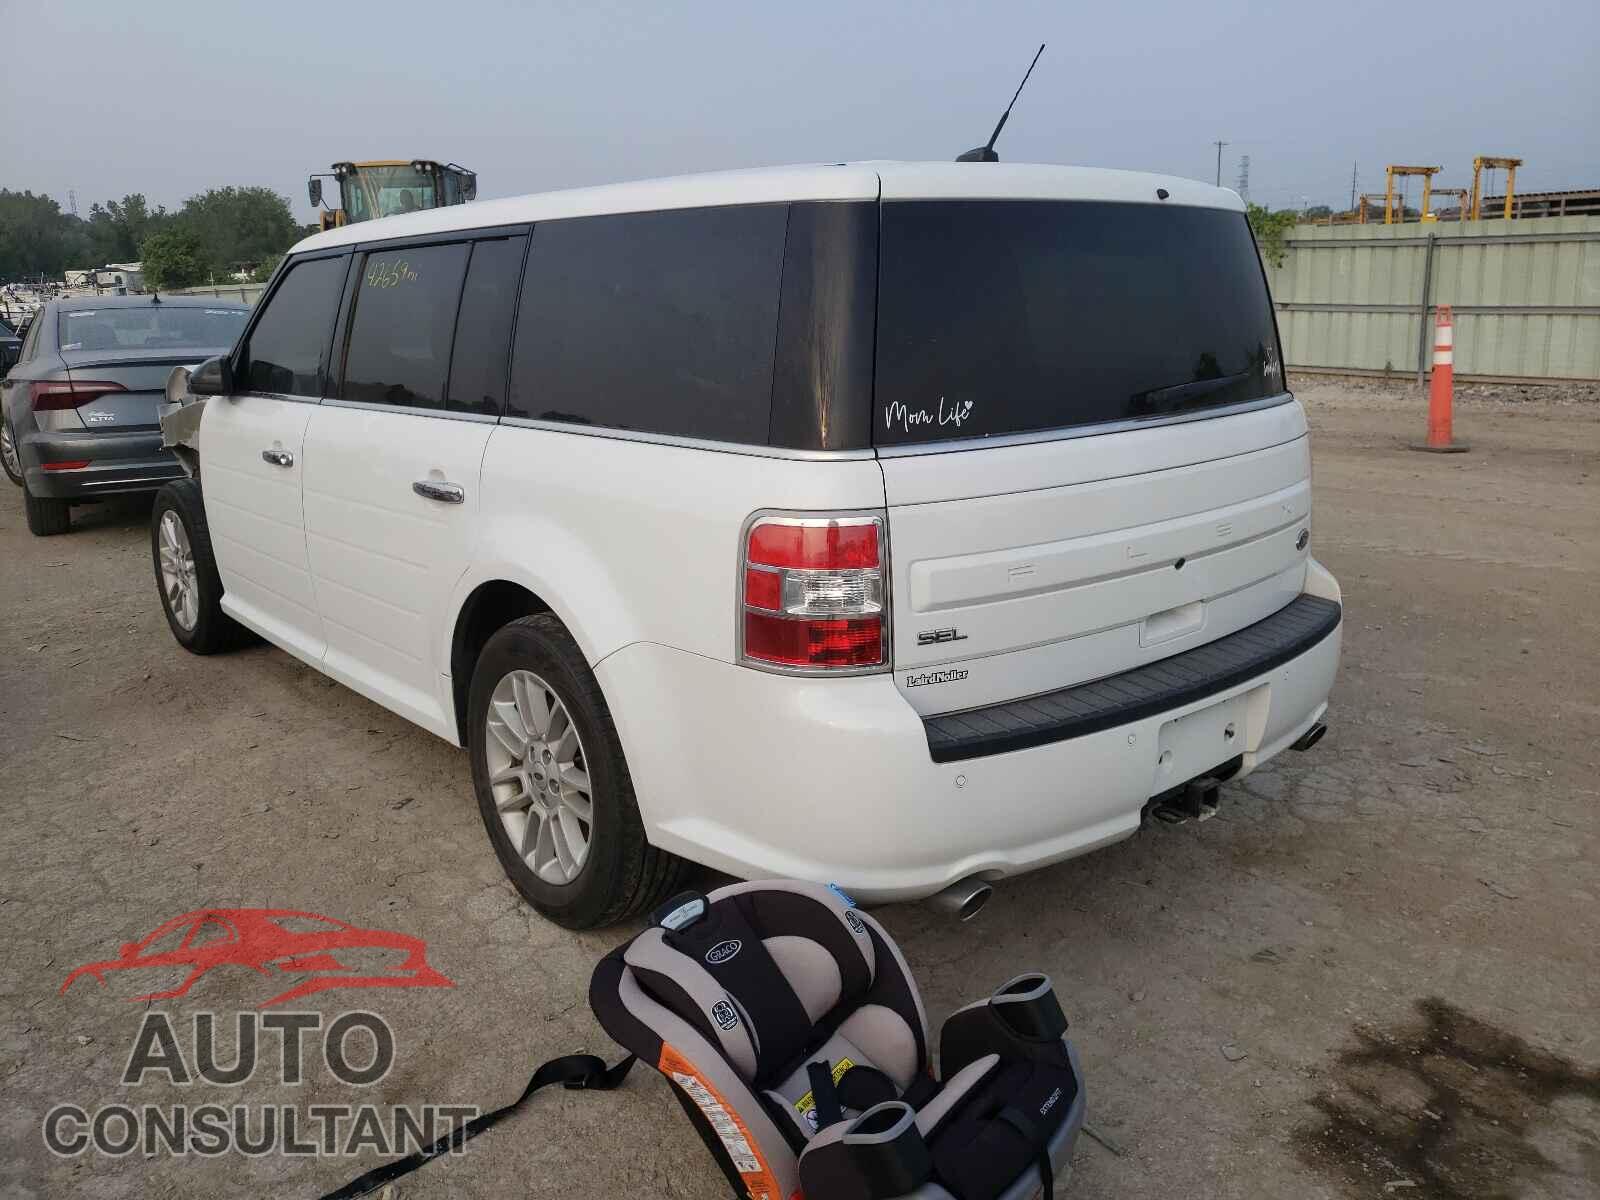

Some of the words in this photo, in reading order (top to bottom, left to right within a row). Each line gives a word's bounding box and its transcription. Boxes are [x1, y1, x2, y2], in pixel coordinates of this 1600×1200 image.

[885, 401, 934, 433] Mom
[938, 396, 970, 427] Life
[917, 627, 968, 646] SEL
[710, 942, 738, 961] GRACO
